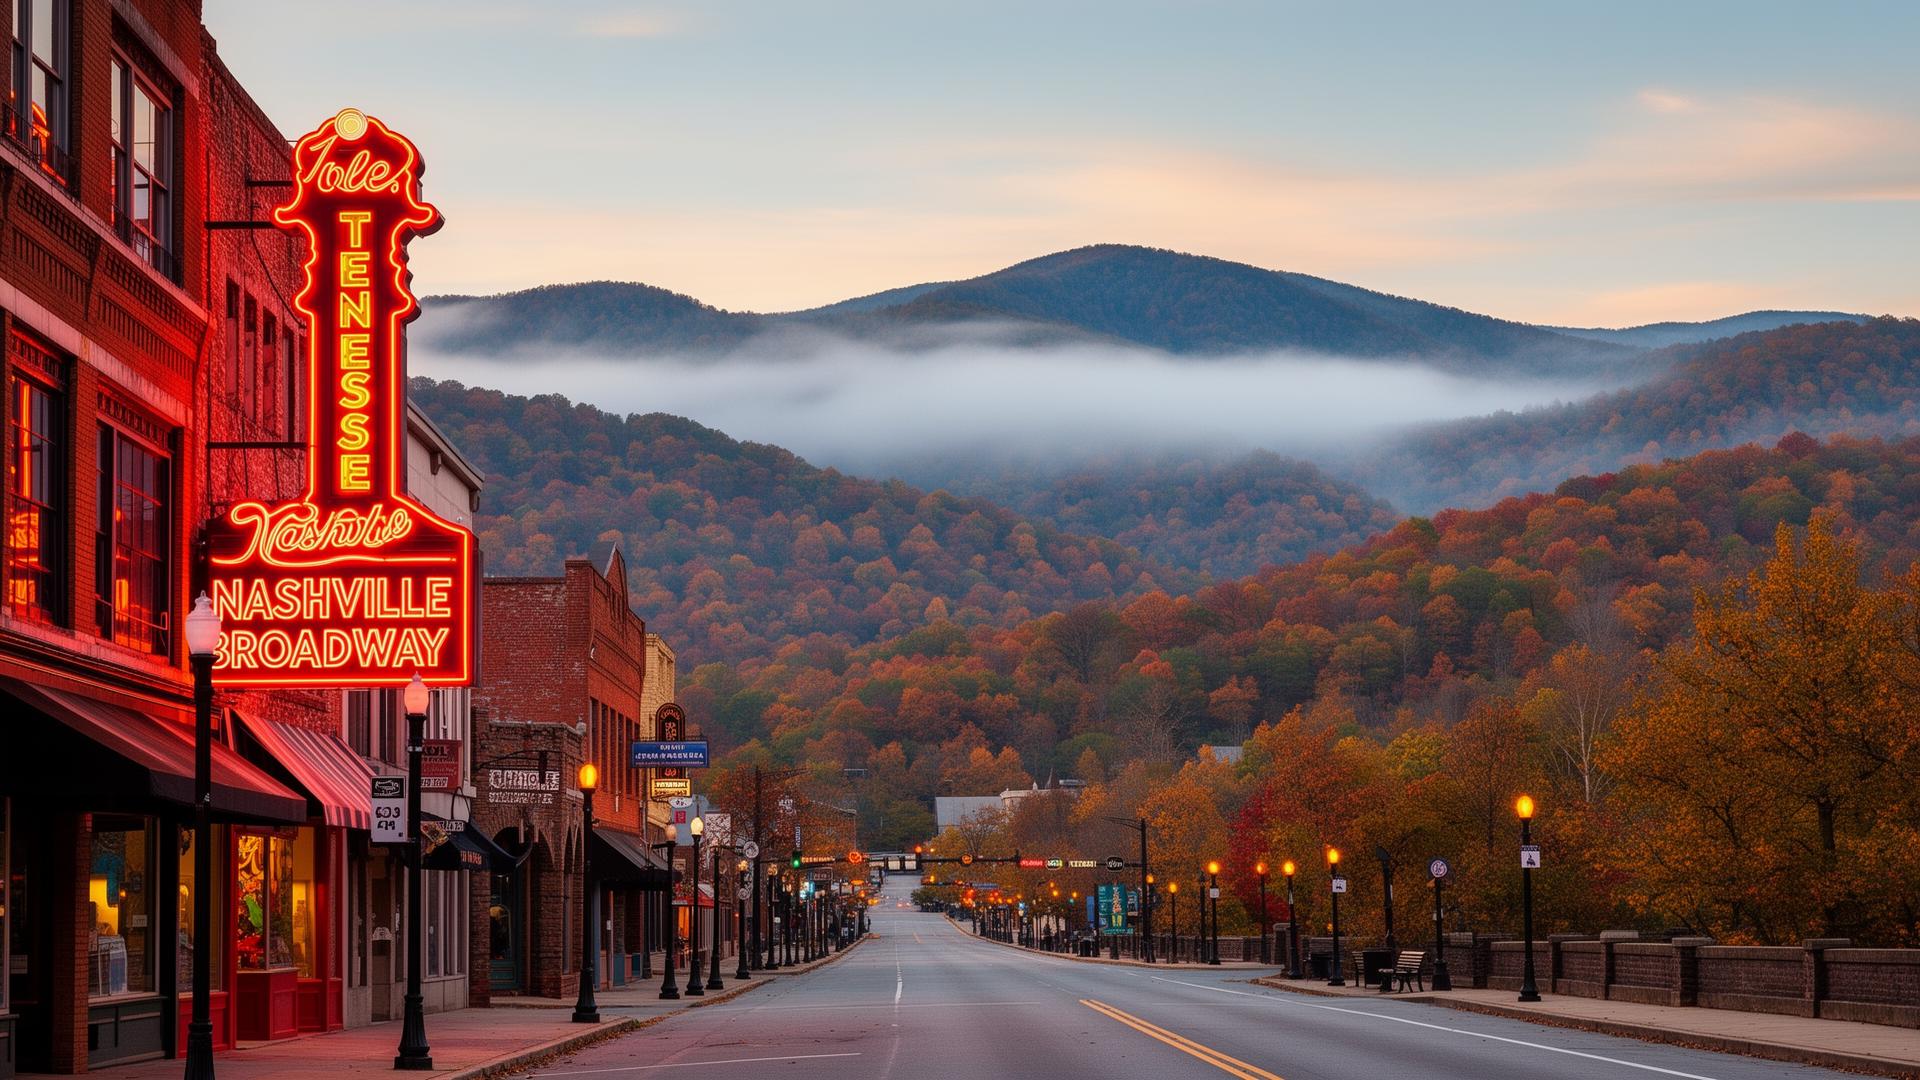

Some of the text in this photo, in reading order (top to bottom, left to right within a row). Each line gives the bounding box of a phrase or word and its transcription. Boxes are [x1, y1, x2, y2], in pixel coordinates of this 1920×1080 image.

[337, 211, 371, 490] TENESSE
[212, 577, 452, 621] NASHVILLE
[211, 627, 449, 670] BROADWAY
